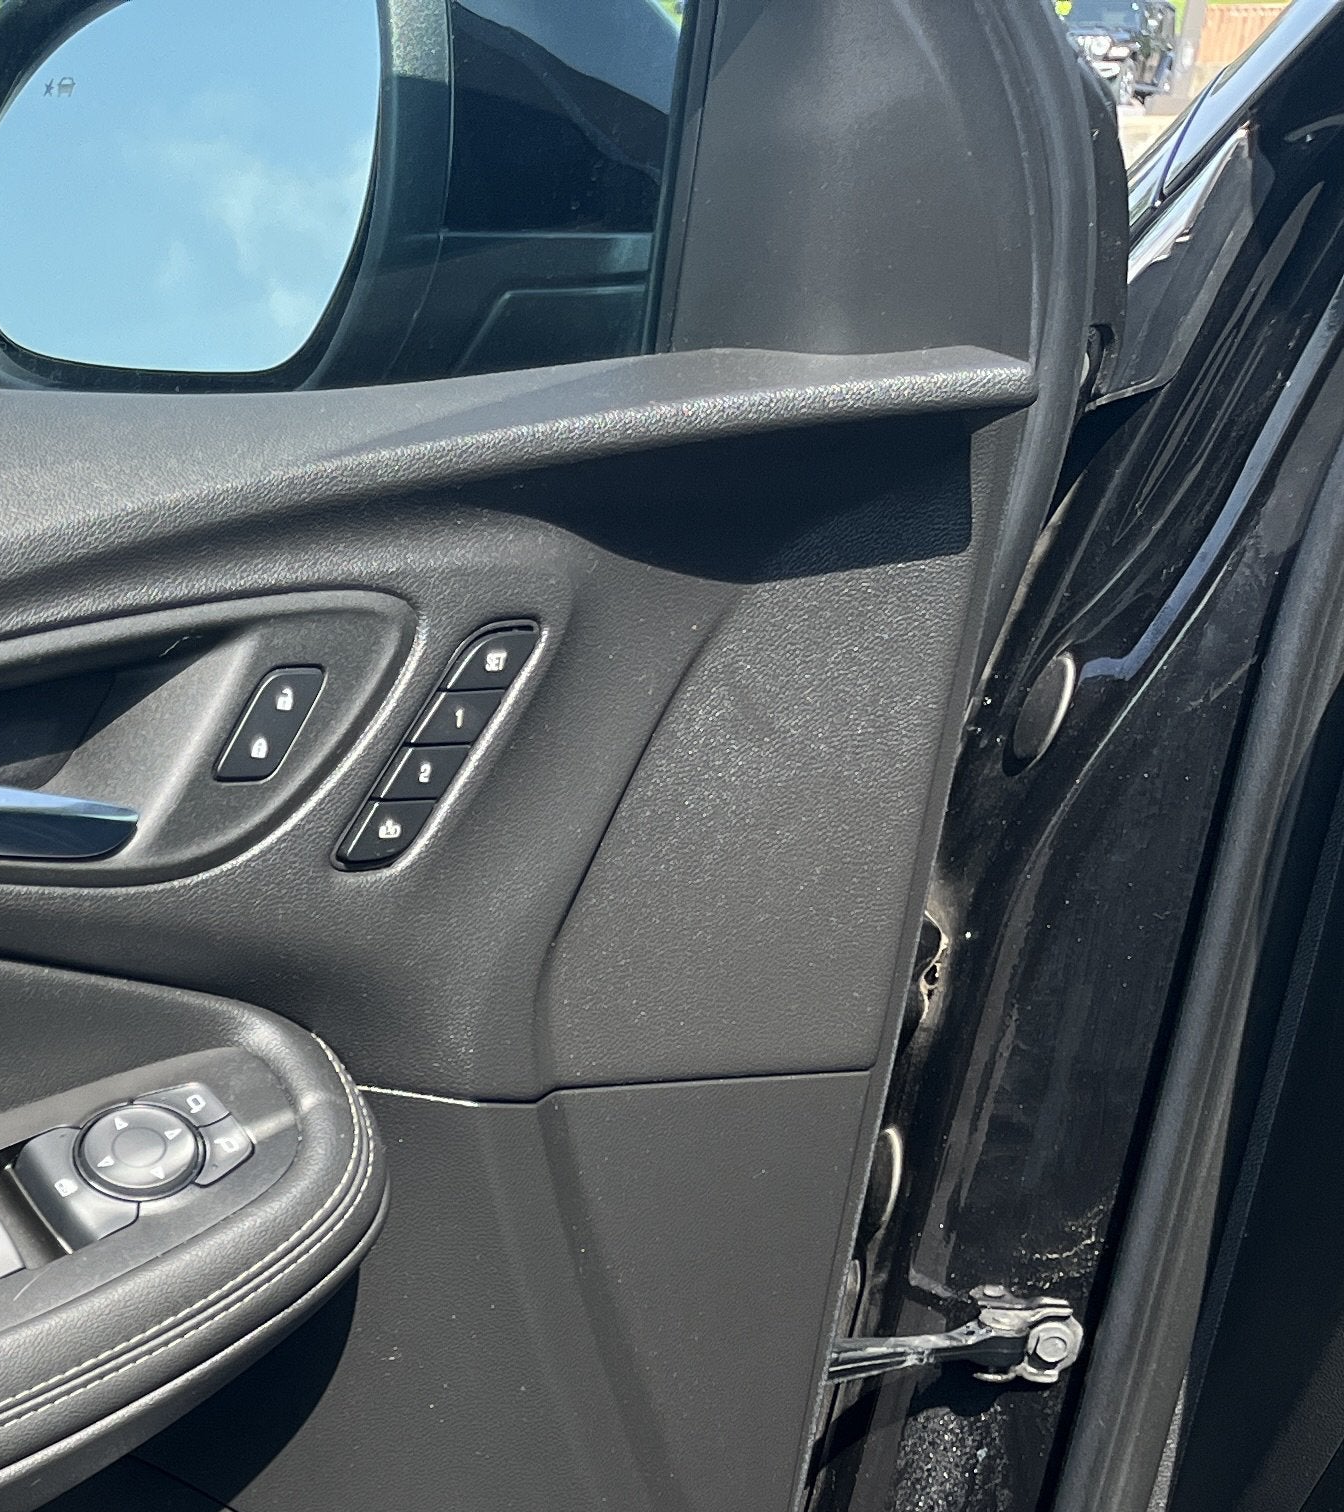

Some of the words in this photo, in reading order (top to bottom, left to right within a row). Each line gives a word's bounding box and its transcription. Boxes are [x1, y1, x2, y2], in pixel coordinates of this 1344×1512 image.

[485, 650, 508, 672] SET
[454, 708, 465, 728] 1
[418, 761, 432, 783] 2
